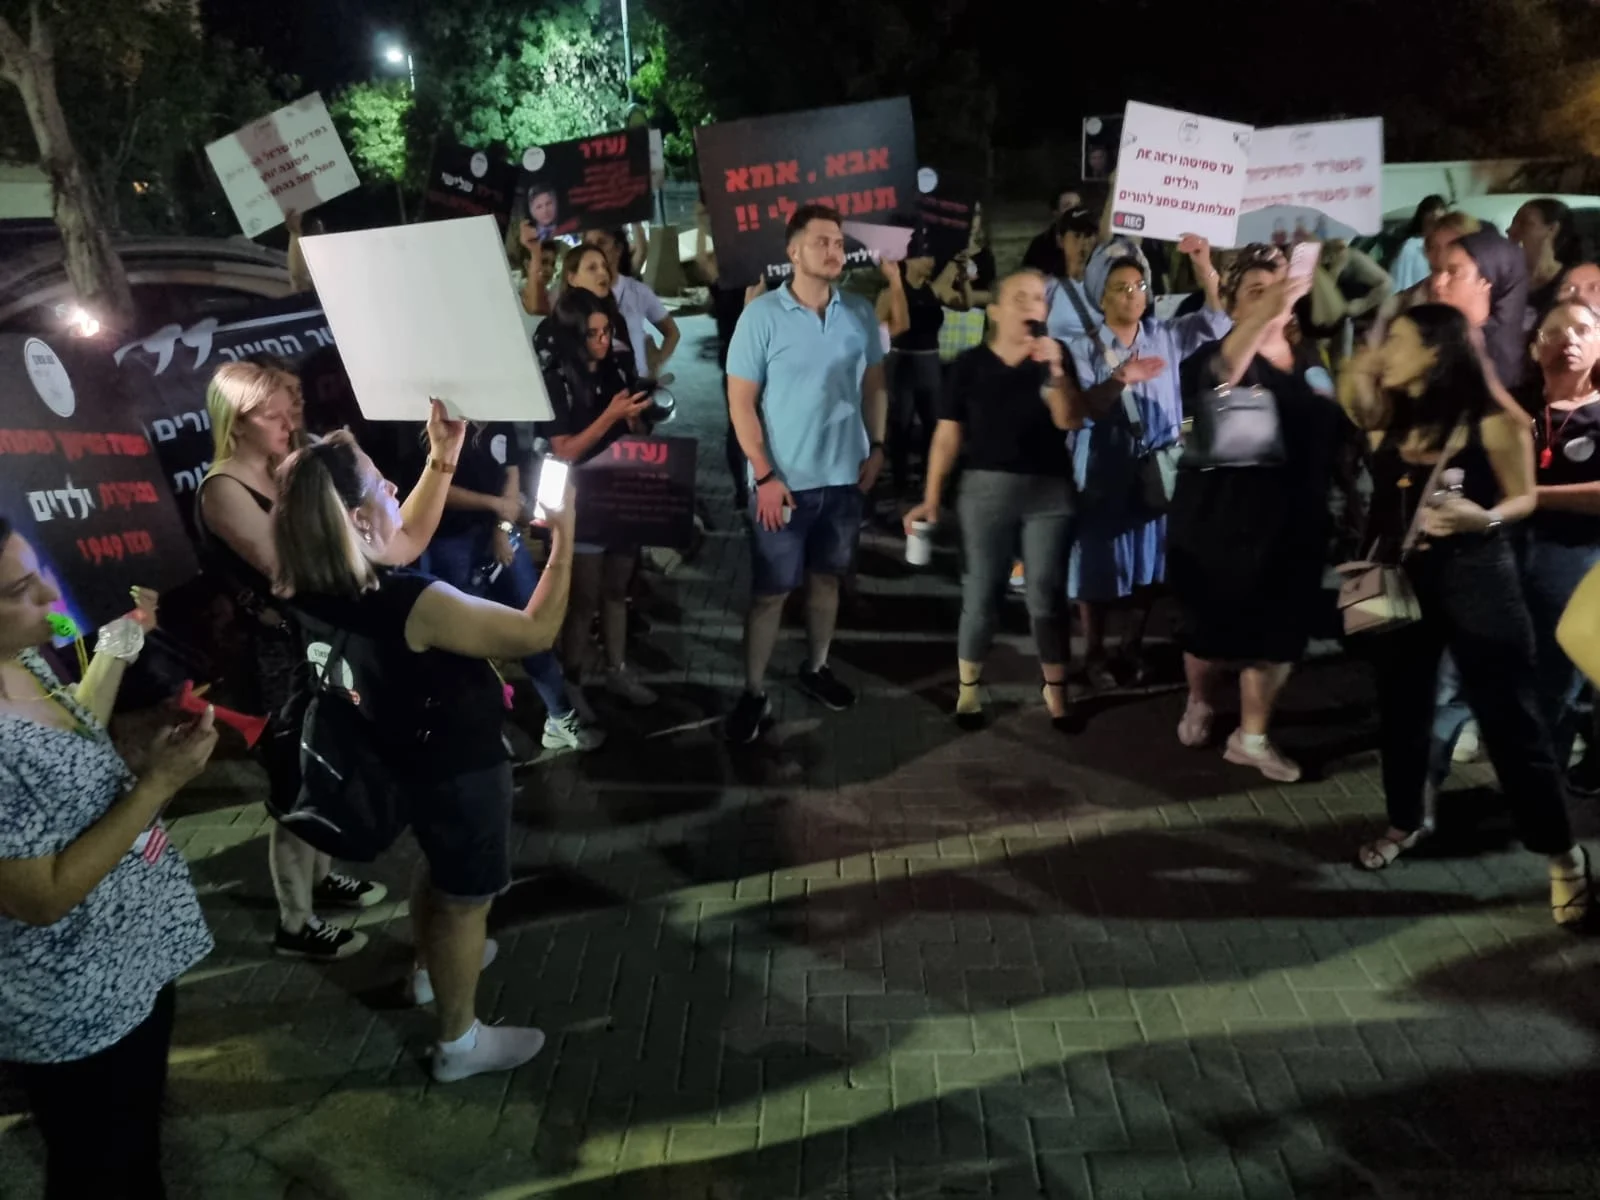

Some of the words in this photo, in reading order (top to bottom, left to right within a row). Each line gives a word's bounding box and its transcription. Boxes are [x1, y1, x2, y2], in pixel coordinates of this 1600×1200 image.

[578, 135, 628, 159] נעדר
[1136, 148, 1152, 160] את
[825, 147, 889, 178] אבא
[1154, 151, 1177, 164] יראה
[1179, 156, 1218, 172] שמישהו
[725, 160, 799, 193] אמא
[1220, 162, 1234, 175] עד
[1163, 175, 1199, 191] הילדים
[1119, 189, 1154, 205] להורים
[1156, 195, 1179, 208] שמע
[768, 196, 798, 224] לי
[1181, 200, 1196, 211] עם
[736, 203, 760, 232] !!
[1123, 215, 1142, 229] REC
[218, 335, 303, 363] החינוך
[152, 409, 210, 442] ורים
[25, 474, 96, 522] ילדים
